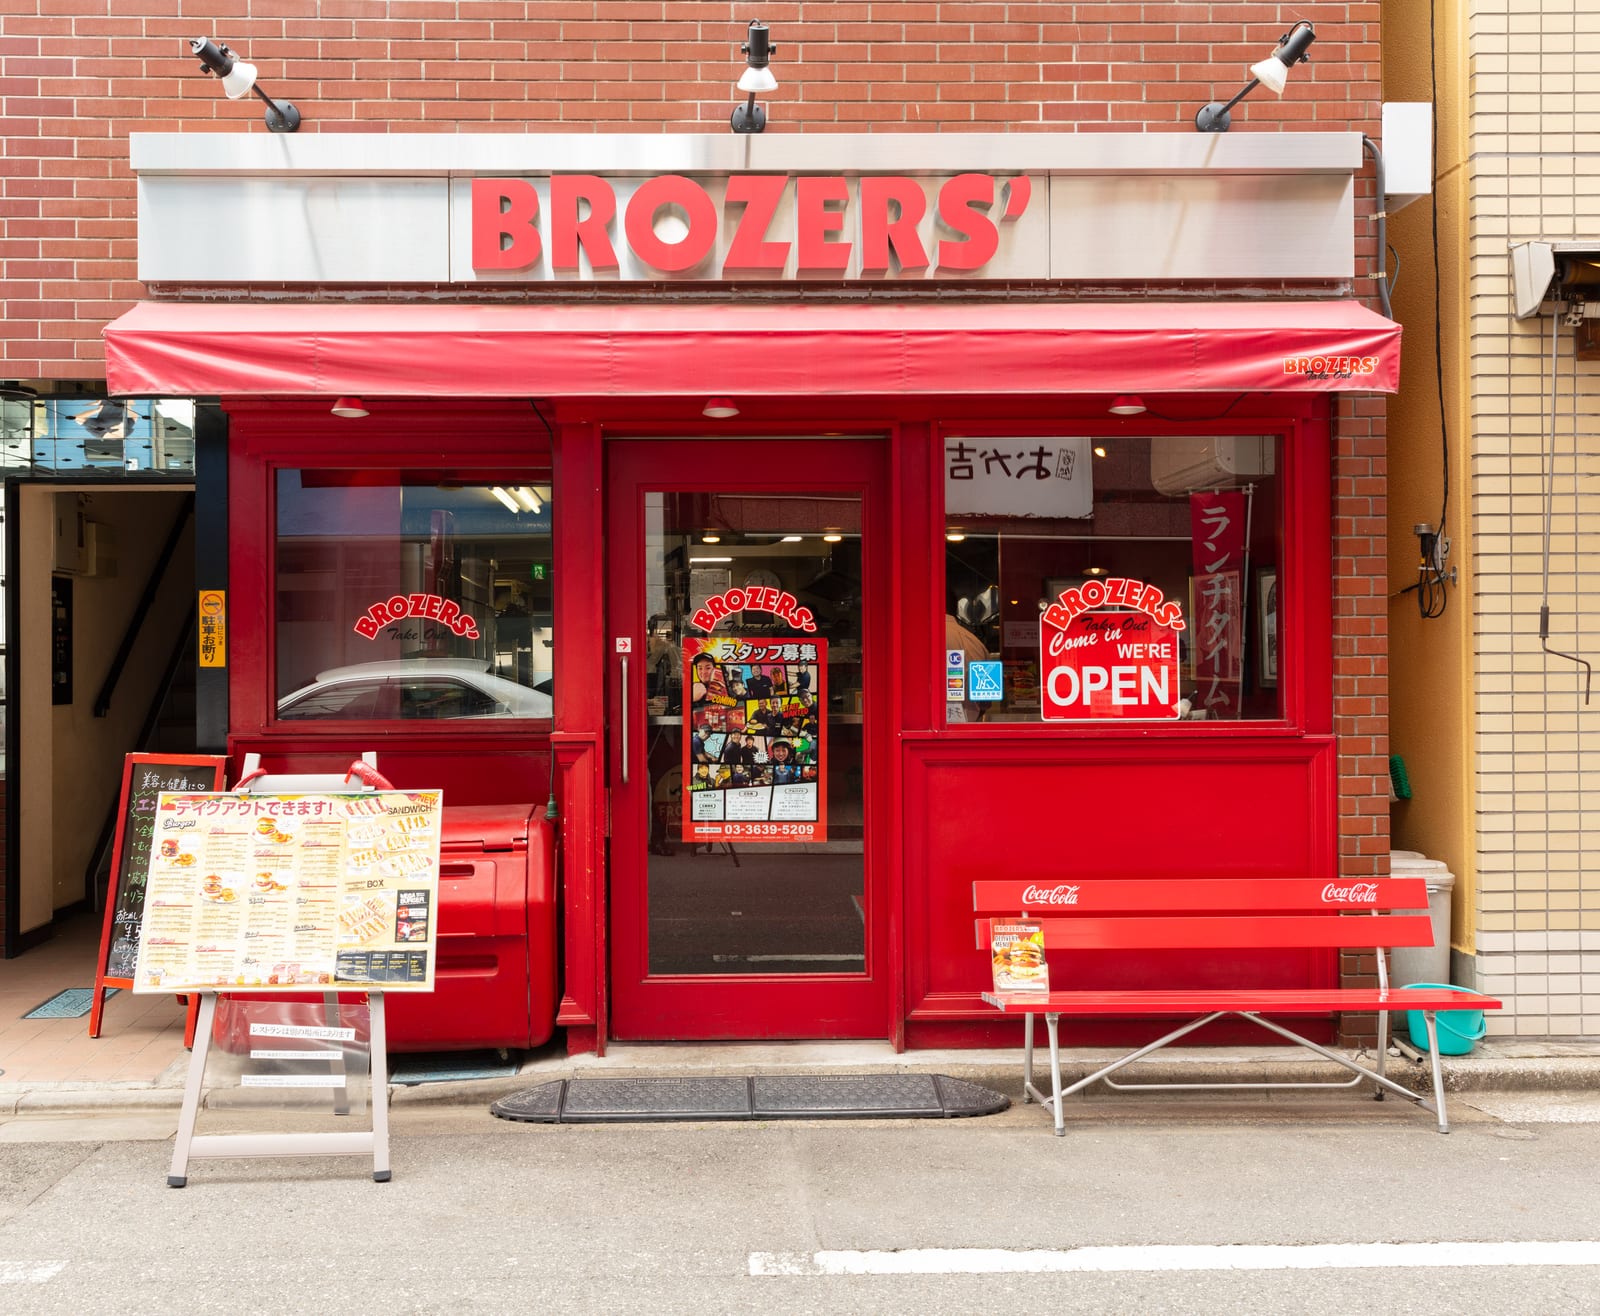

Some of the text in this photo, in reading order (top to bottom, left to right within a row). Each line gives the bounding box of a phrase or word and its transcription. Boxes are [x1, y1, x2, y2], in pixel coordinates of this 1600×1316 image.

[471, 173, 1032, 277] BROZERS'
[1283, 356, 1379, 374] BROZERS'
[1305, 370, 1352, 380] Take Out
[691, 586, 817, 633] BROZERS'
[1043, 578, 1186, 631] BROZERS'
[1200, 506, 1231, 707] ランチタイム
[354, 594, 479, 640] BROZERS'
[1081, 617, 1148, 631] Take Out
[202, 615, 216, 663] 駐車お断り
[387, 627, 418, 640] Take
[1049, 631, 1098, 656] Come
[1104, 628, 1123, 642] in
[721, 643, 817, 661] スタッフ募集
[1117, 643, 1171, 659] WE'RE
[1047, 665, 1170, 707] OPEN
[711, 695, 737, 707] COMING
[388, 804, 432, 815] SANDWICH
[417, 796, 439, 806] NEW
[163, 818, 197, 830] Burgers
[724, 824, 814, 835] 03-3639-5209
[367, 880, 384, 888] BOX
[1321, 883, 1379, 903] Coca-Cola
[1022, 885, 1080, 905] Coca-Cola
